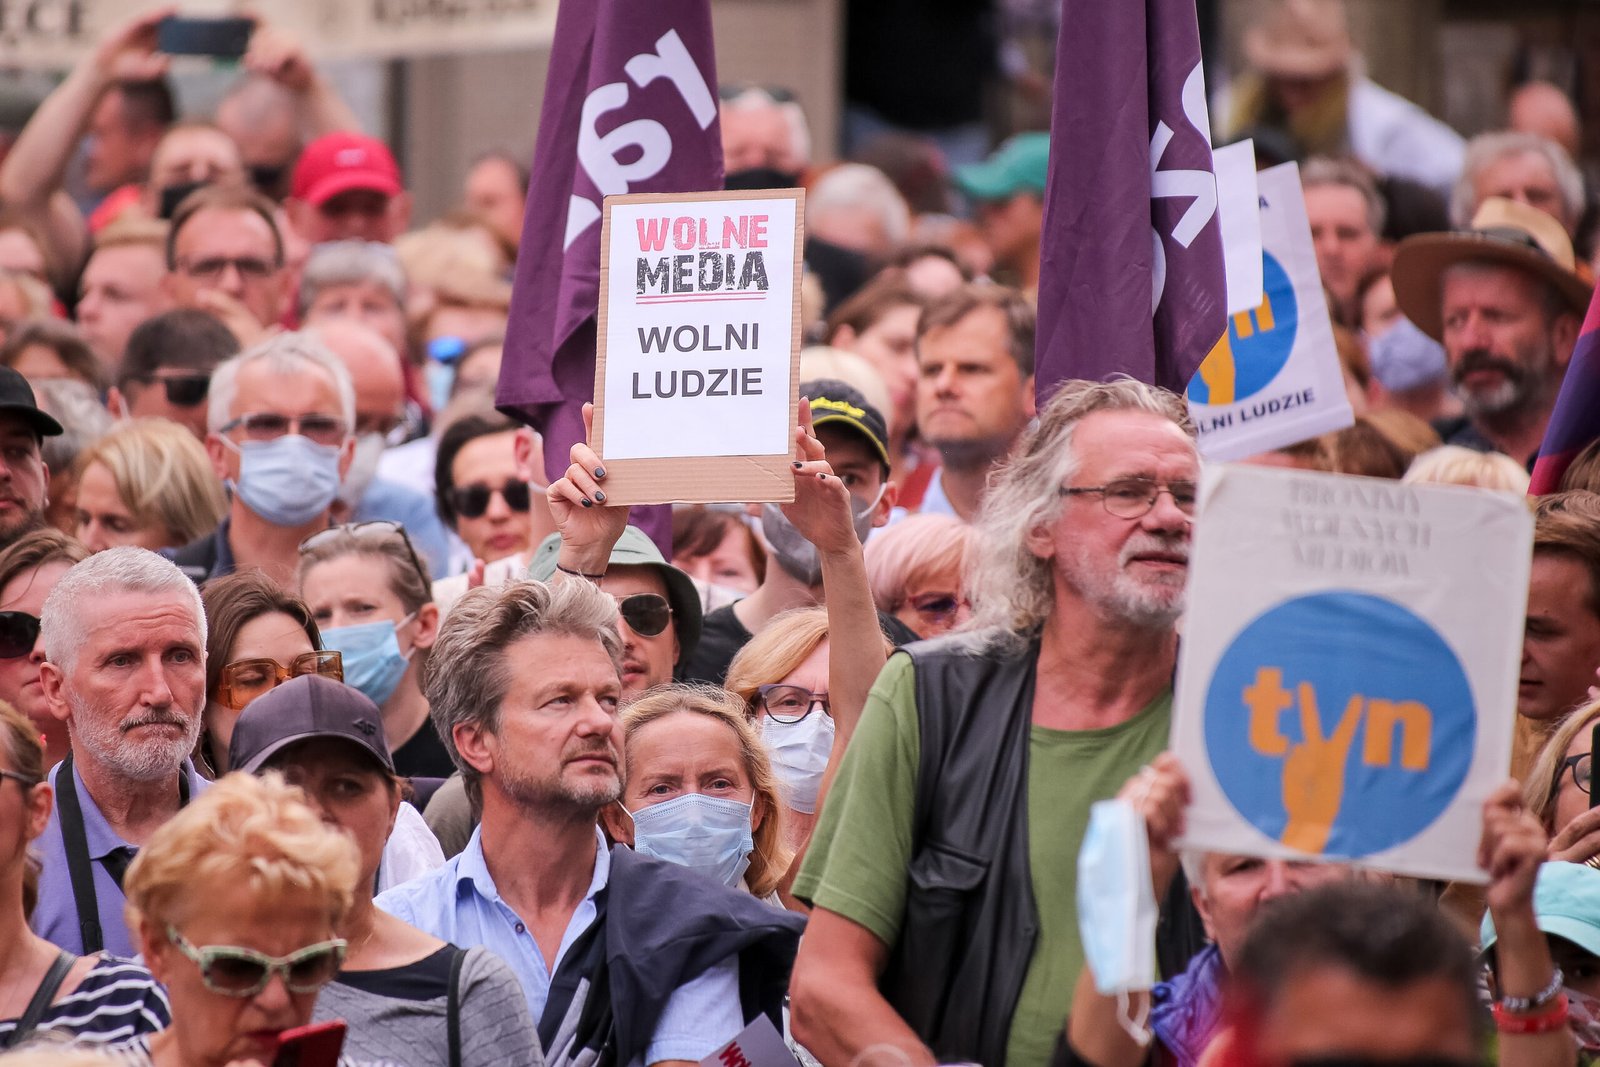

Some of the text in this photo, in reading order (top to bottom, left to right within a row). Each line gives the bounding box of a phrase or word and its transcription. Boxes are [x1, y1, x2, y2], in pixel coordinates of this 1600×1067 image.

[636, 214, 769, 252] WOLNE
[636, 251, 769, 294] MEDIA
[637, 322, 759, 354] WOLNI
[632, 367, 763, 399] LUDZIE
[1196, 387, 1316, 434] LNI LUDZIE
